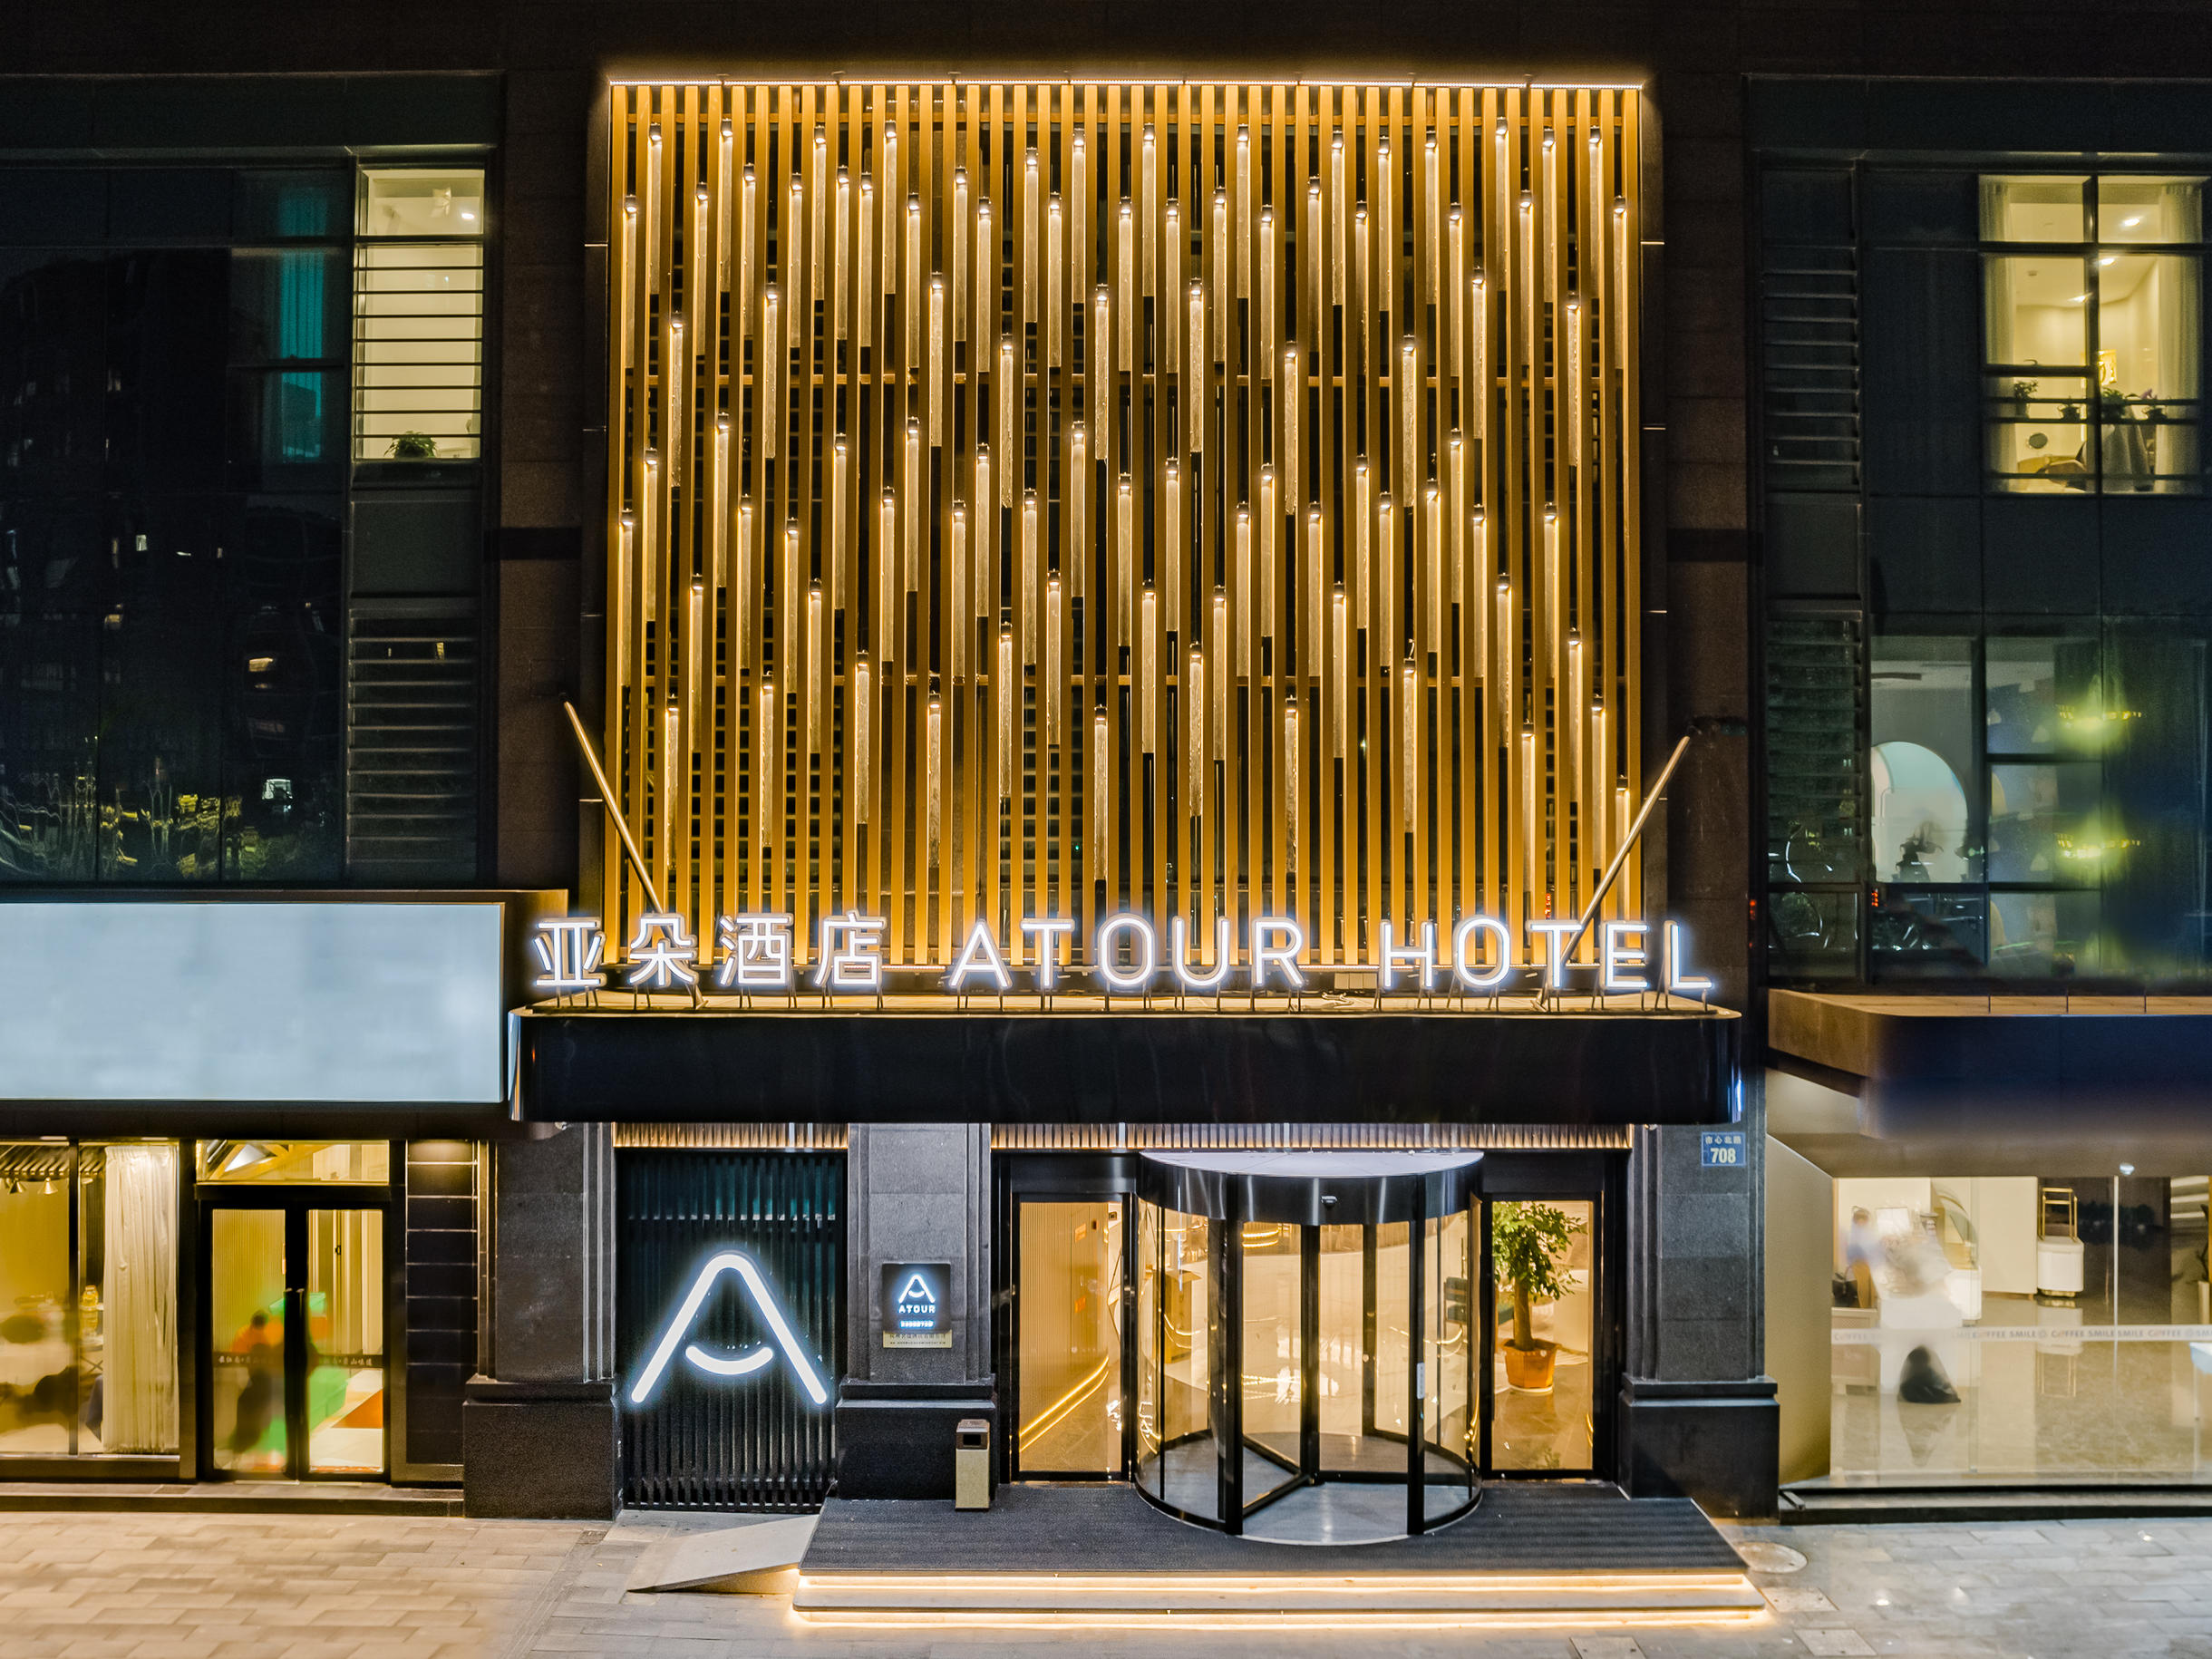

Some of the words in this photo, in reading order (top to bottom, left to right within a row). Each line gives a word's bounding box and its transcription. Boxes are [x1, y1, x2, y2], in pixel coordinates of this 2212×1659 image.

[533, 910, 888, 988] 亚朵酒店
[948, 914, 1305, 990] ATOUR
[1379, 915, 1714, 991] HOTEL
[1710, 1147, 1736, 1164] 708
[898, 1305, 936, 1314] ATOUR
[2088, 1329, 2115, 1337] SMILE
